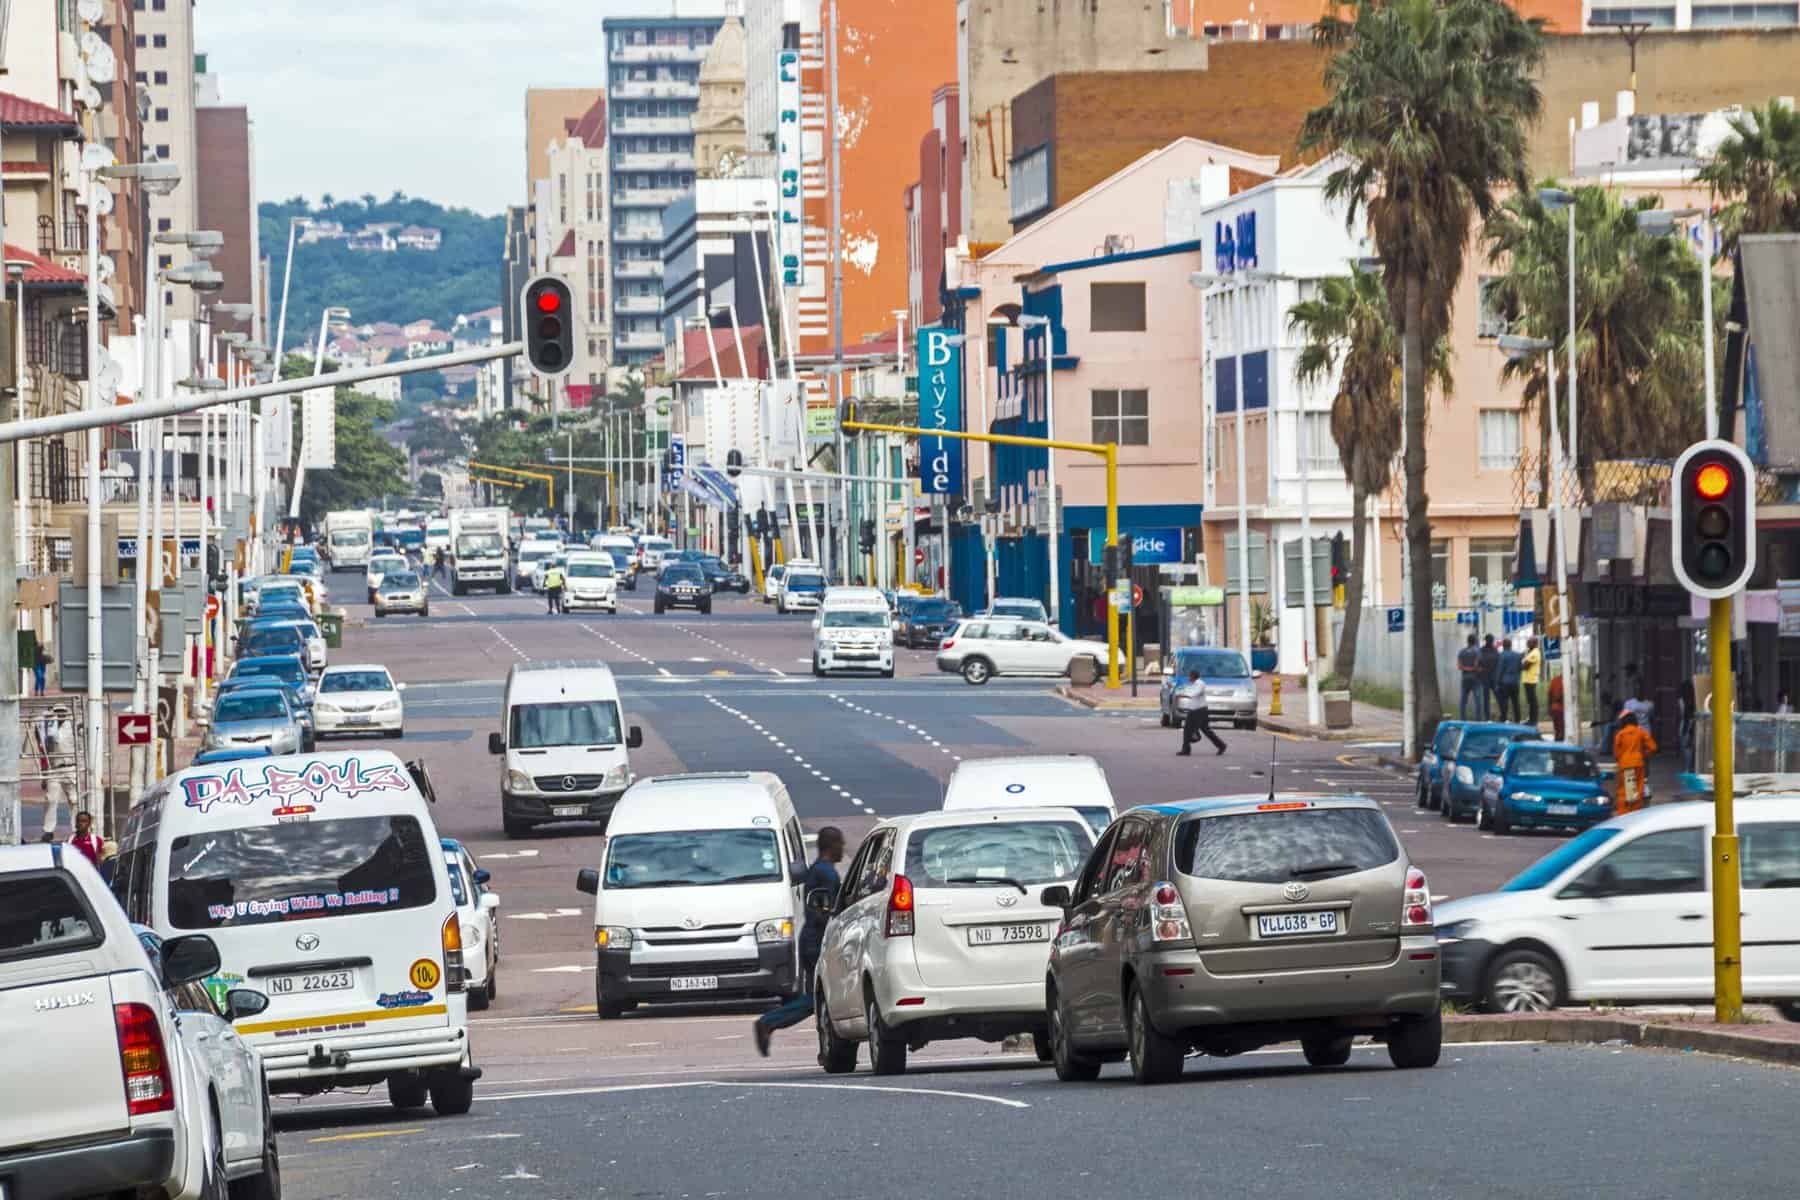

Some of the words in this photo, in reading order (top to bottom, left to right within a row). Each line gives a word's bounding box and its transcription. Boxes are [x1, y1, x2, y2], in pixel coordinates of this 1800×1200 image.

[928, 332, 951, 491] Bayside
[208, 904, 235, 920] Why
[236, 902, 248, 915] U
[290, 895, 324, 910] While
[326, 894, 343, 907] We
[1319, 913, 1335, 929] GP
[975, 928, 992, 942] ND
[1002, 925, 1042, 940] 73598
[273, 978, 293, 993] ND
[303, 973, 348, 990] 22623
